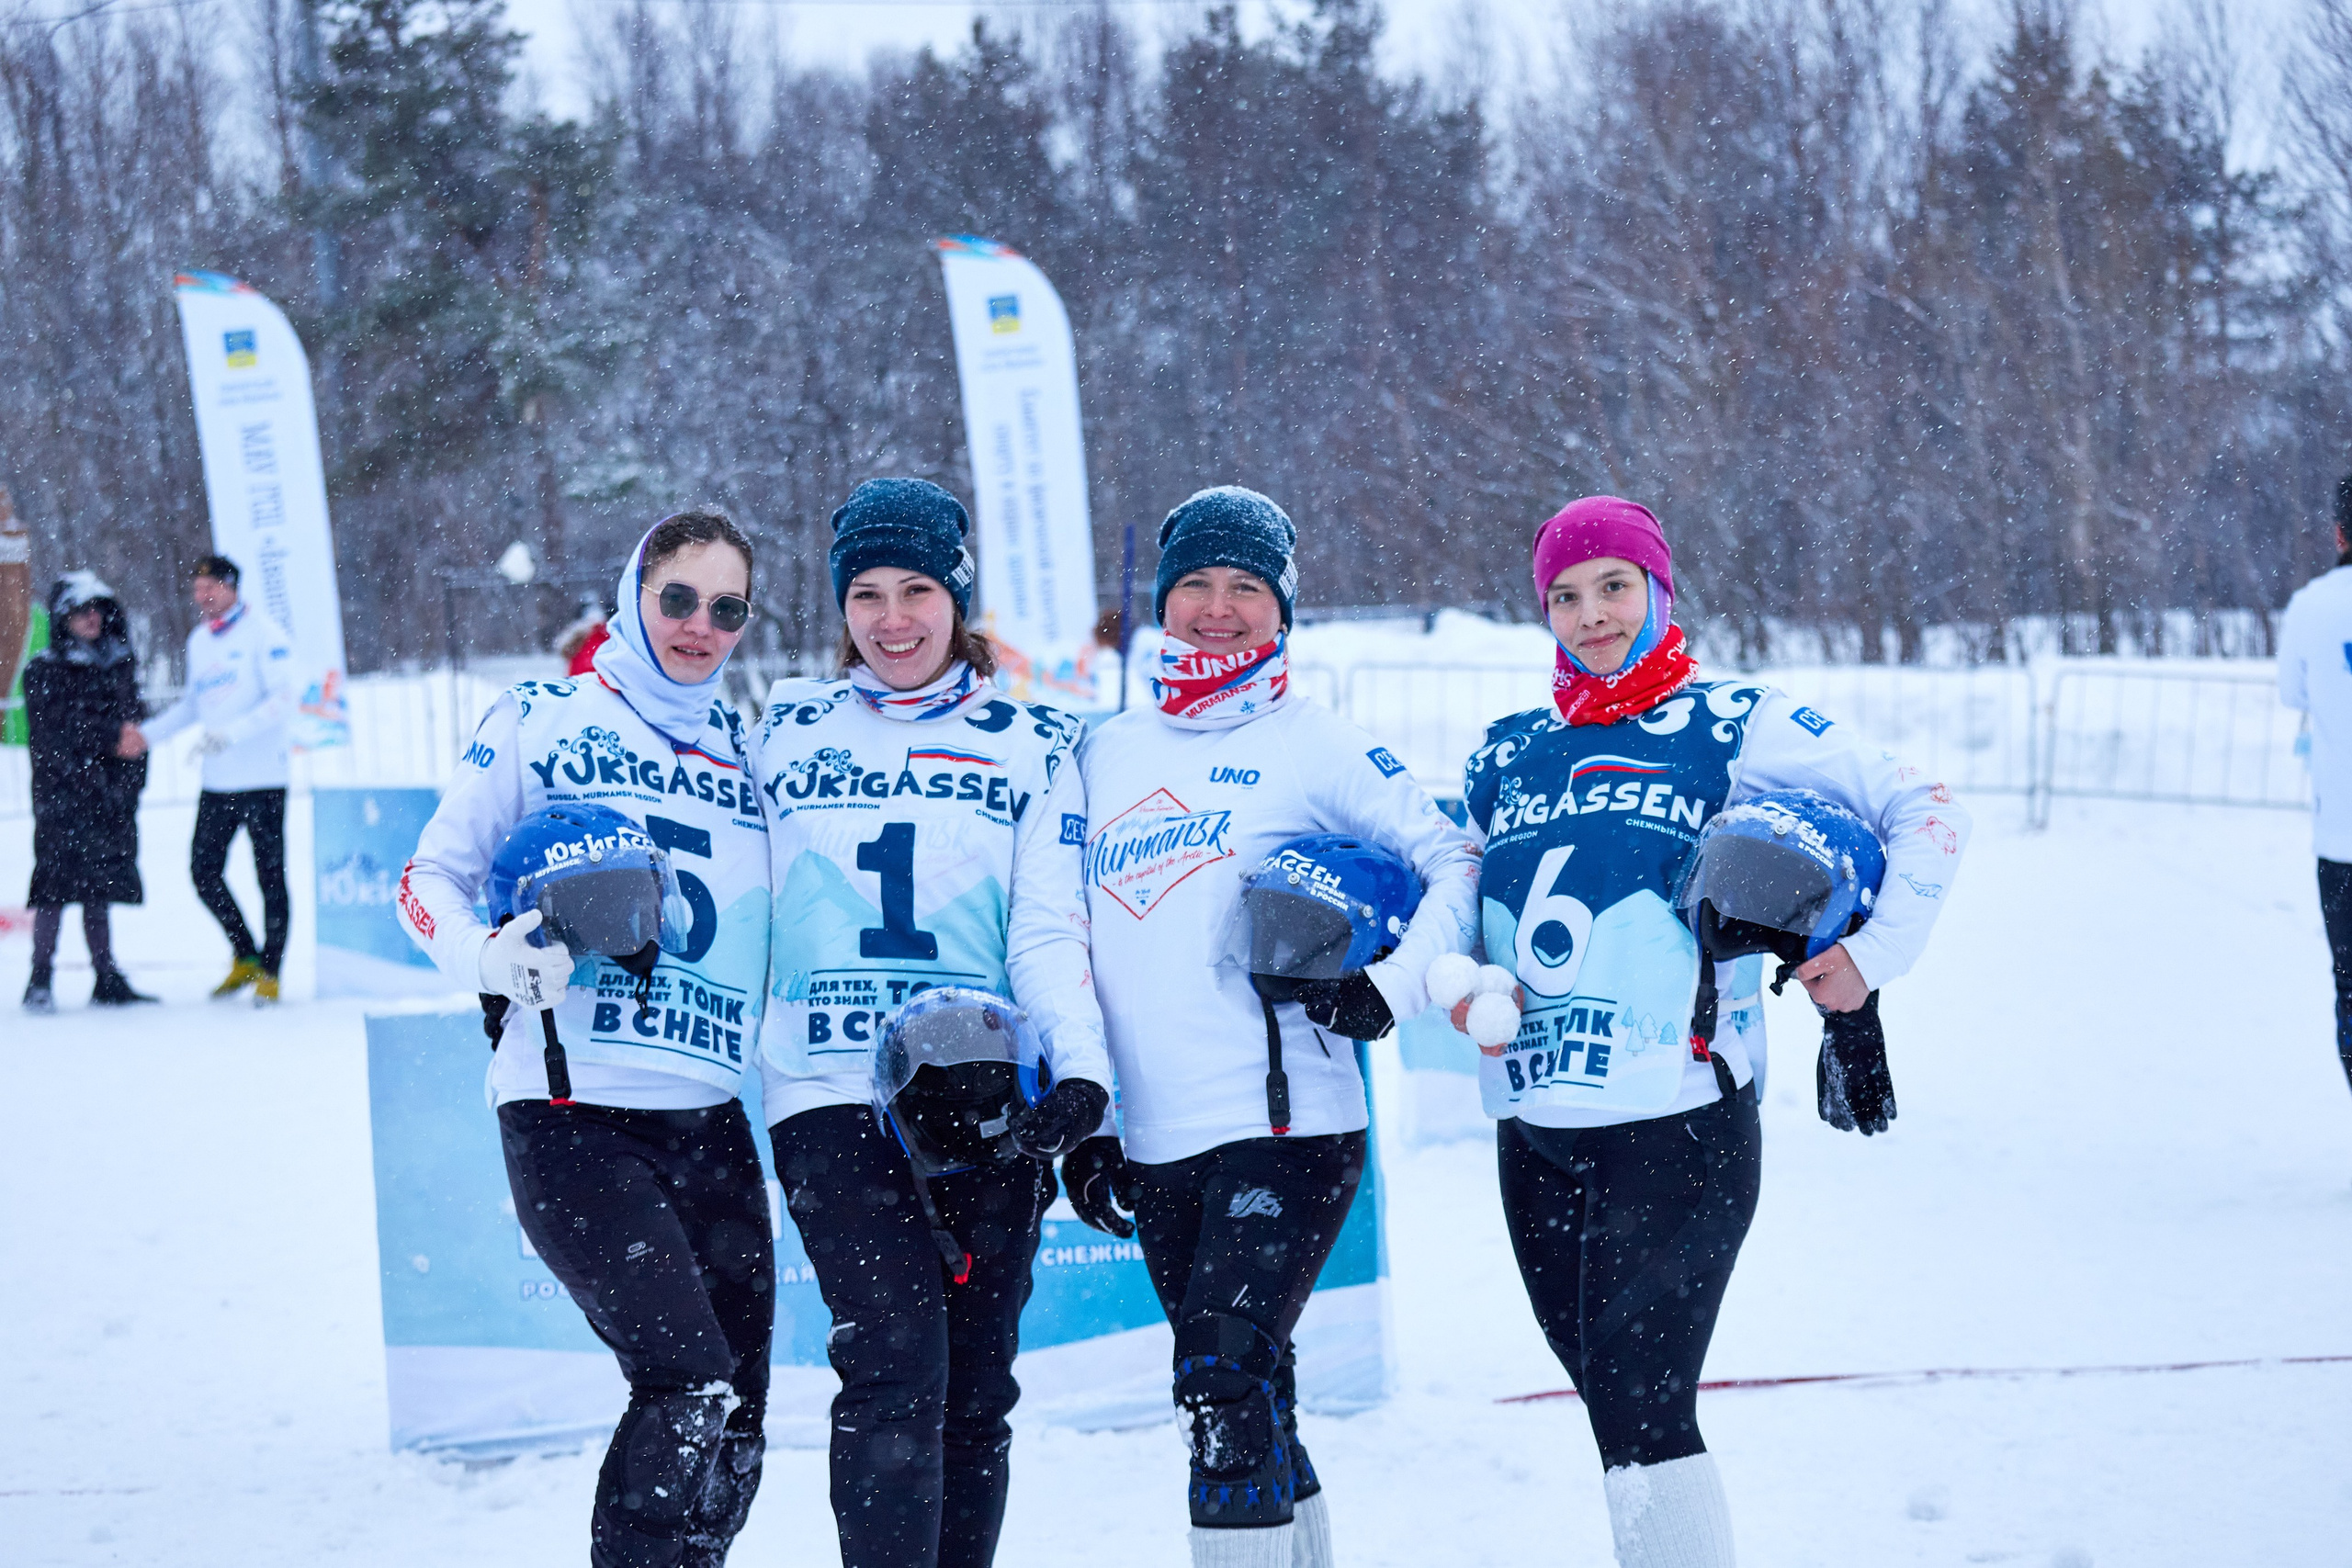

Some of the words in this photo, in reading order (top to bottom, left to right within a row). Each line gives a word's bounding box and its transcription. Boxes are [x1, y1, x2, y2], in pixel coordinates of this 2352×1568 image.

[1209, 766, 1261, 785] UNO
[583, 791, 633, 800] MURMANSK
[634, 792, 662, 804] REGION
[797, 803, 844, 811] MURMANSK
[846, 802, 881, 811] REGION
[975, 808, 1013, 827] СНЕЖНЫ
[1510, 830, 1539, 842] REGION
[1625, 818, 1677, 837] СНЕЖНЫЙ
[1084, 810, 1232, 888] Murmansk
[1178, 850, 1204, 865] Arctic
[535, 858, 581, 879] МУРМАНСК
[645, 814, 718, 964] 5
[856, 821, 939, 962] 1
[1312, 882, 1347, 900] ПЕРВЫЕ
[1317, 891, 1350, 911] РОССИИ
[1513, 843, 1594, 998] 6
[599, 974, 635, 987] ДЛЯ
[809, 980, 840, 995] ДЛЯ
[842, 980, 877, 993] ТЕХ,
[597, 987, 626, 999] КТО
[679, 978, 745, 1026] ТОЛК
[808, 996, 831, 1008] КТО
[833, 995, 878, 1006] ЗНАЕТ
[592, 1002, 622, 1032] В
[632, 1006, 742, 1064] СНЕГЕ
[808, 1011, 832, 1044] В
[1520, 1035, 1549, 1051] ЗНАЕТ
[1505, 1058, 1526, 1092] В
